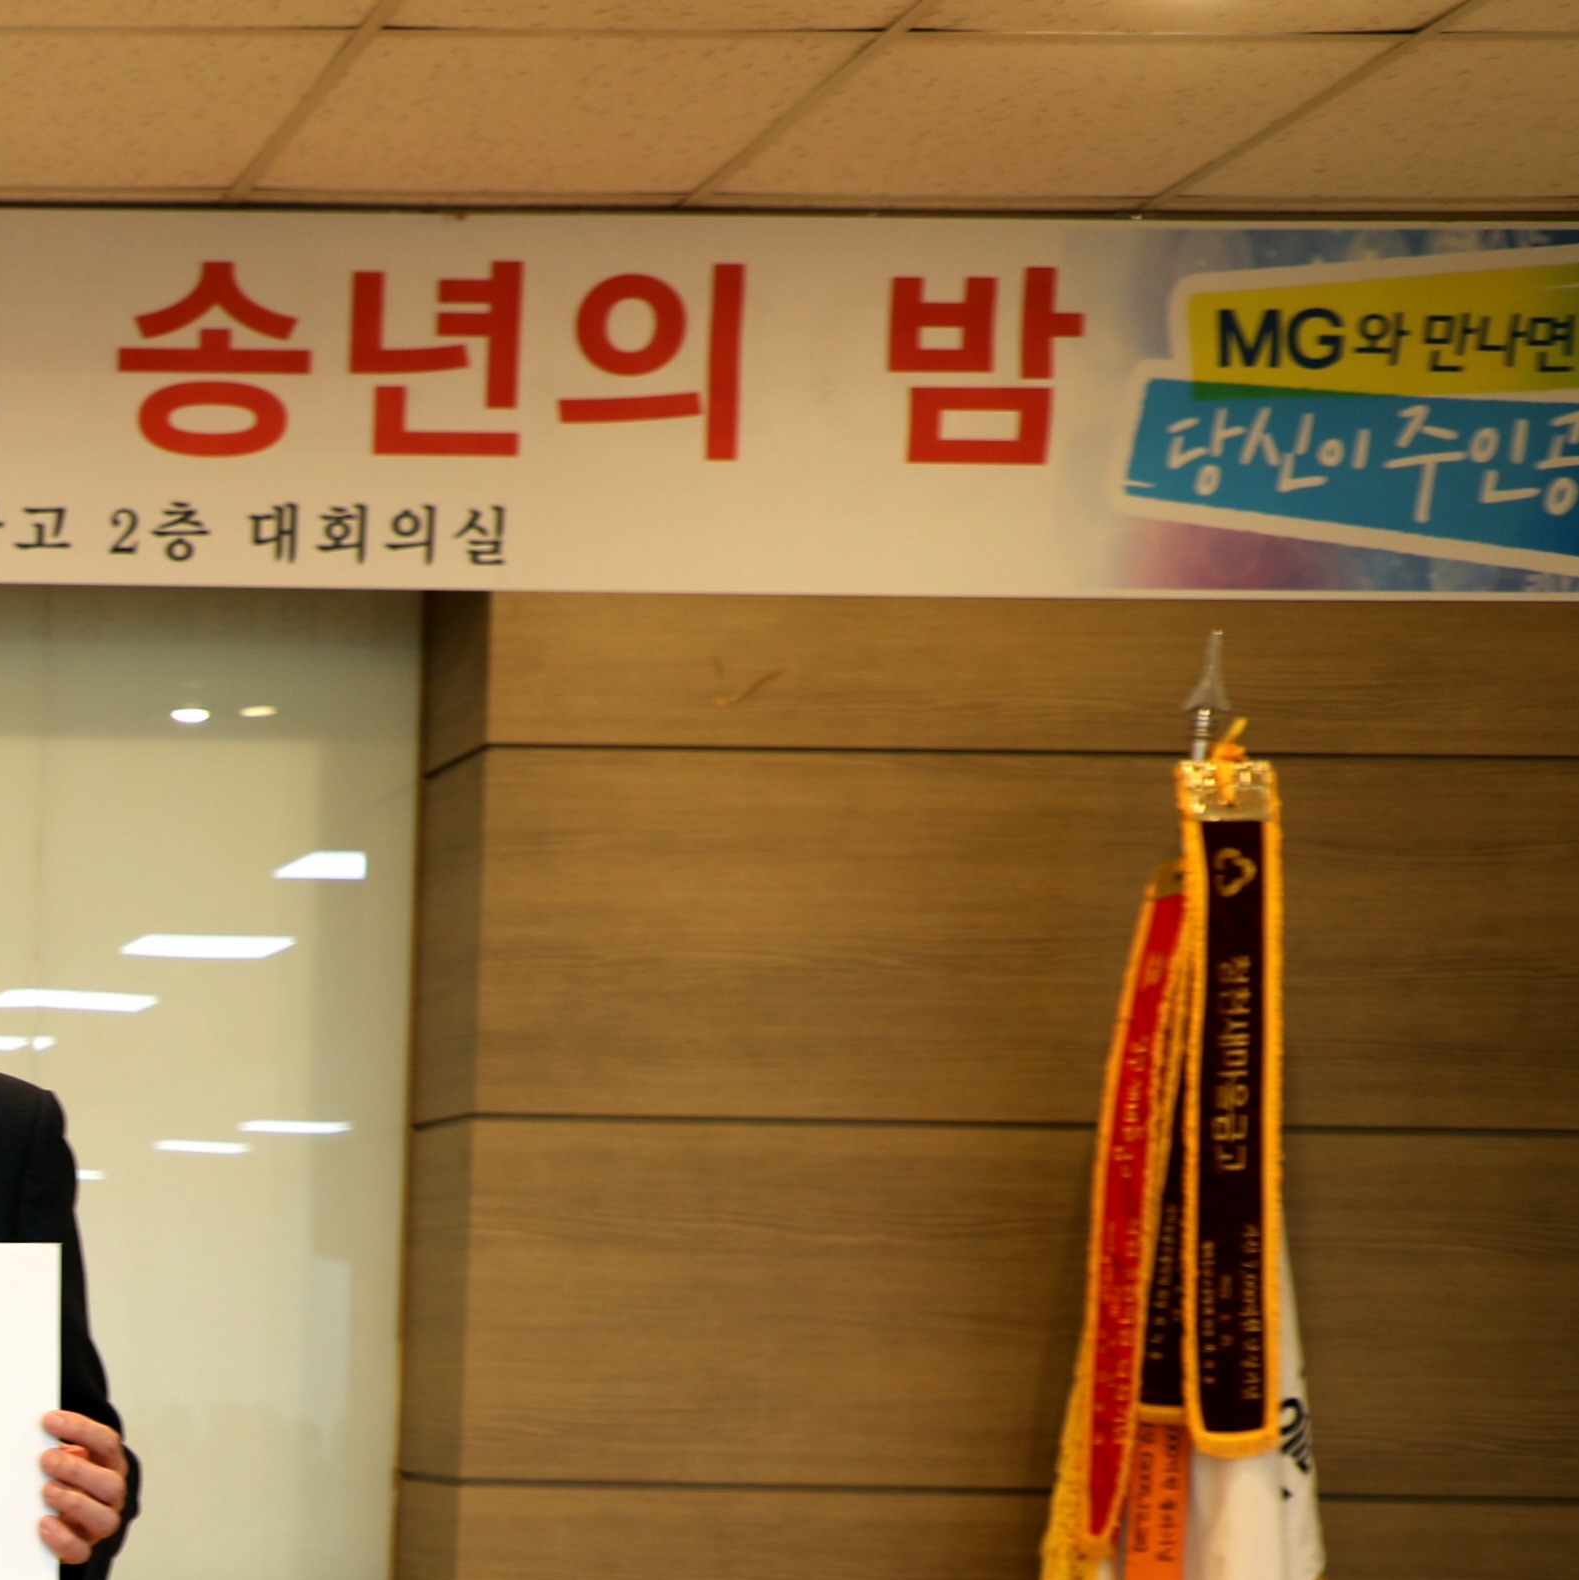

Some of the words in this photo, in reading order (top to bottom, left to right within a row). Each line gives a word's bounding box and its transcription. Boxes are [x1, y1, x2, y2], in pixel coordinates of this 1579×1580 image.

[115, 259, 747, 461] 송년의
[887, 265, 1085, 466] 밤
[1216, 306, 1410, 369] MG와
[1424, 311, 1577, 373] 만나면
[1164, 405, 1373, 497] 당신이
[108, 500, 211, 563] 2층
[247, 501, 507, 567] 대회의실
